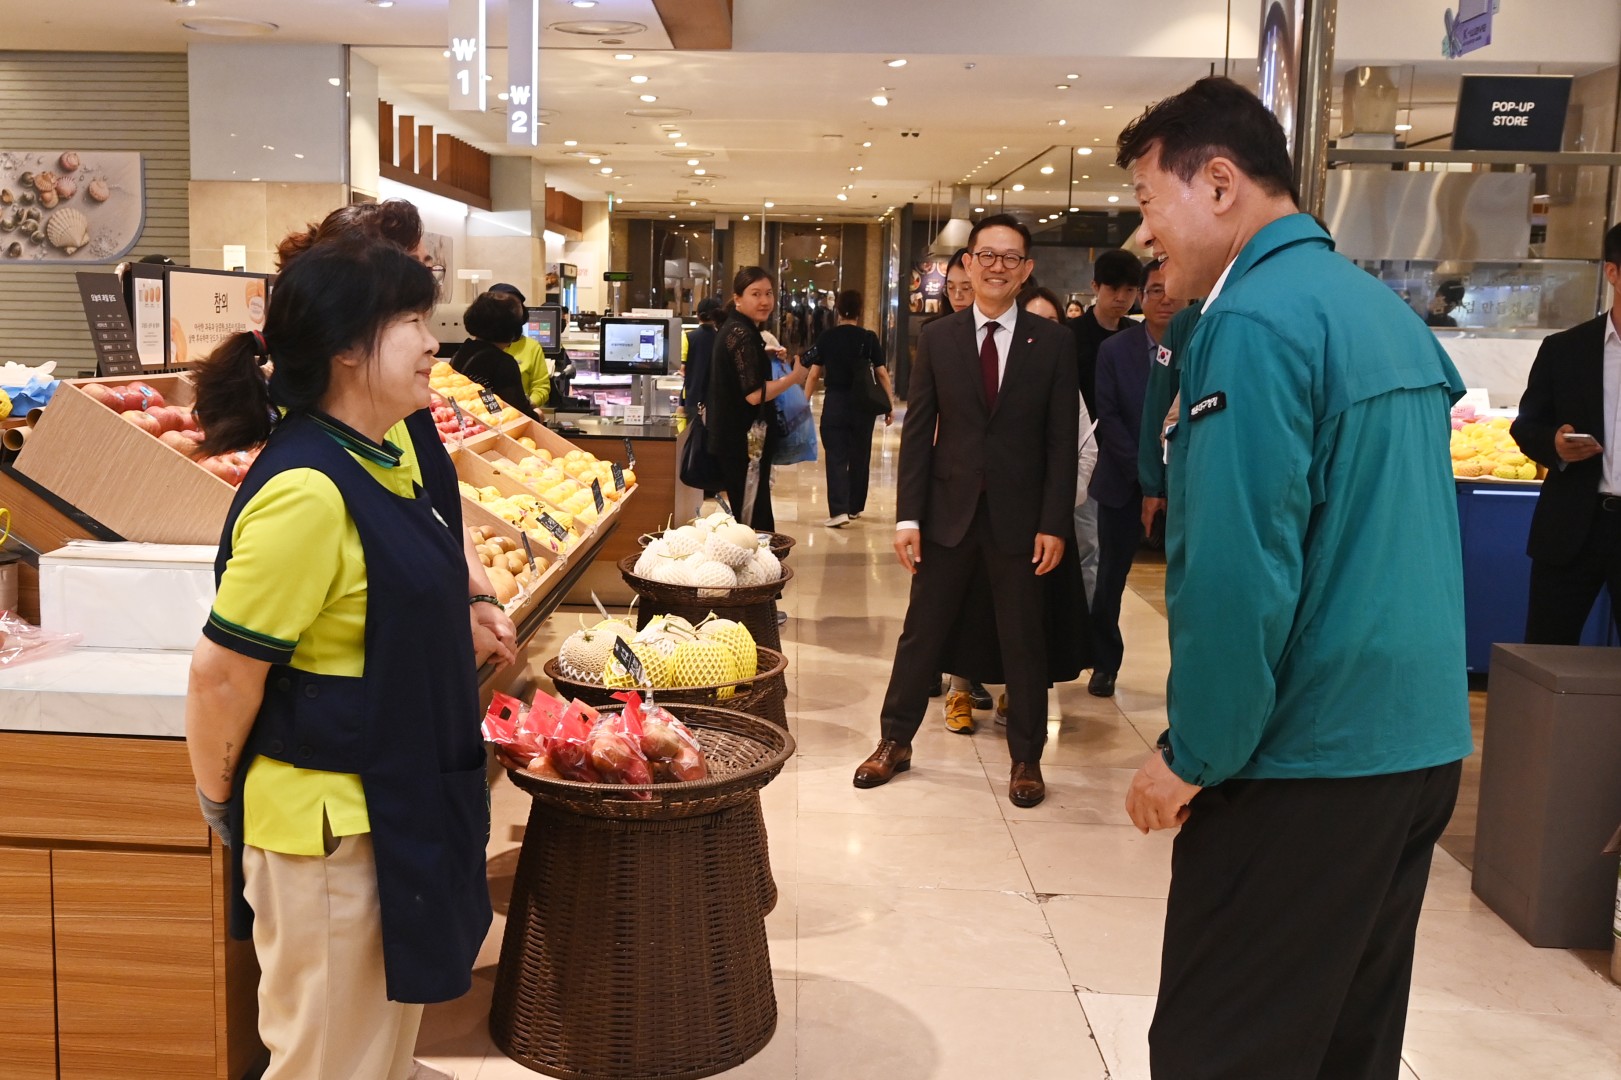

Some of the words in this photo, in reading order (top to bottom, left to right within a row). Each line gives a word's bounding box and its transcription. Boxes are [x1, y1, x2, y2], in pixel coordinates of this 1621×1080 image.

[457, 69, 469, 95] 1
[1491, 101, 1535, 112] POP-UP
[511, 110, 528, 133] 2
[1492, 115, 1529, 126] STORE
[214, 292, 228, 314] 참외
